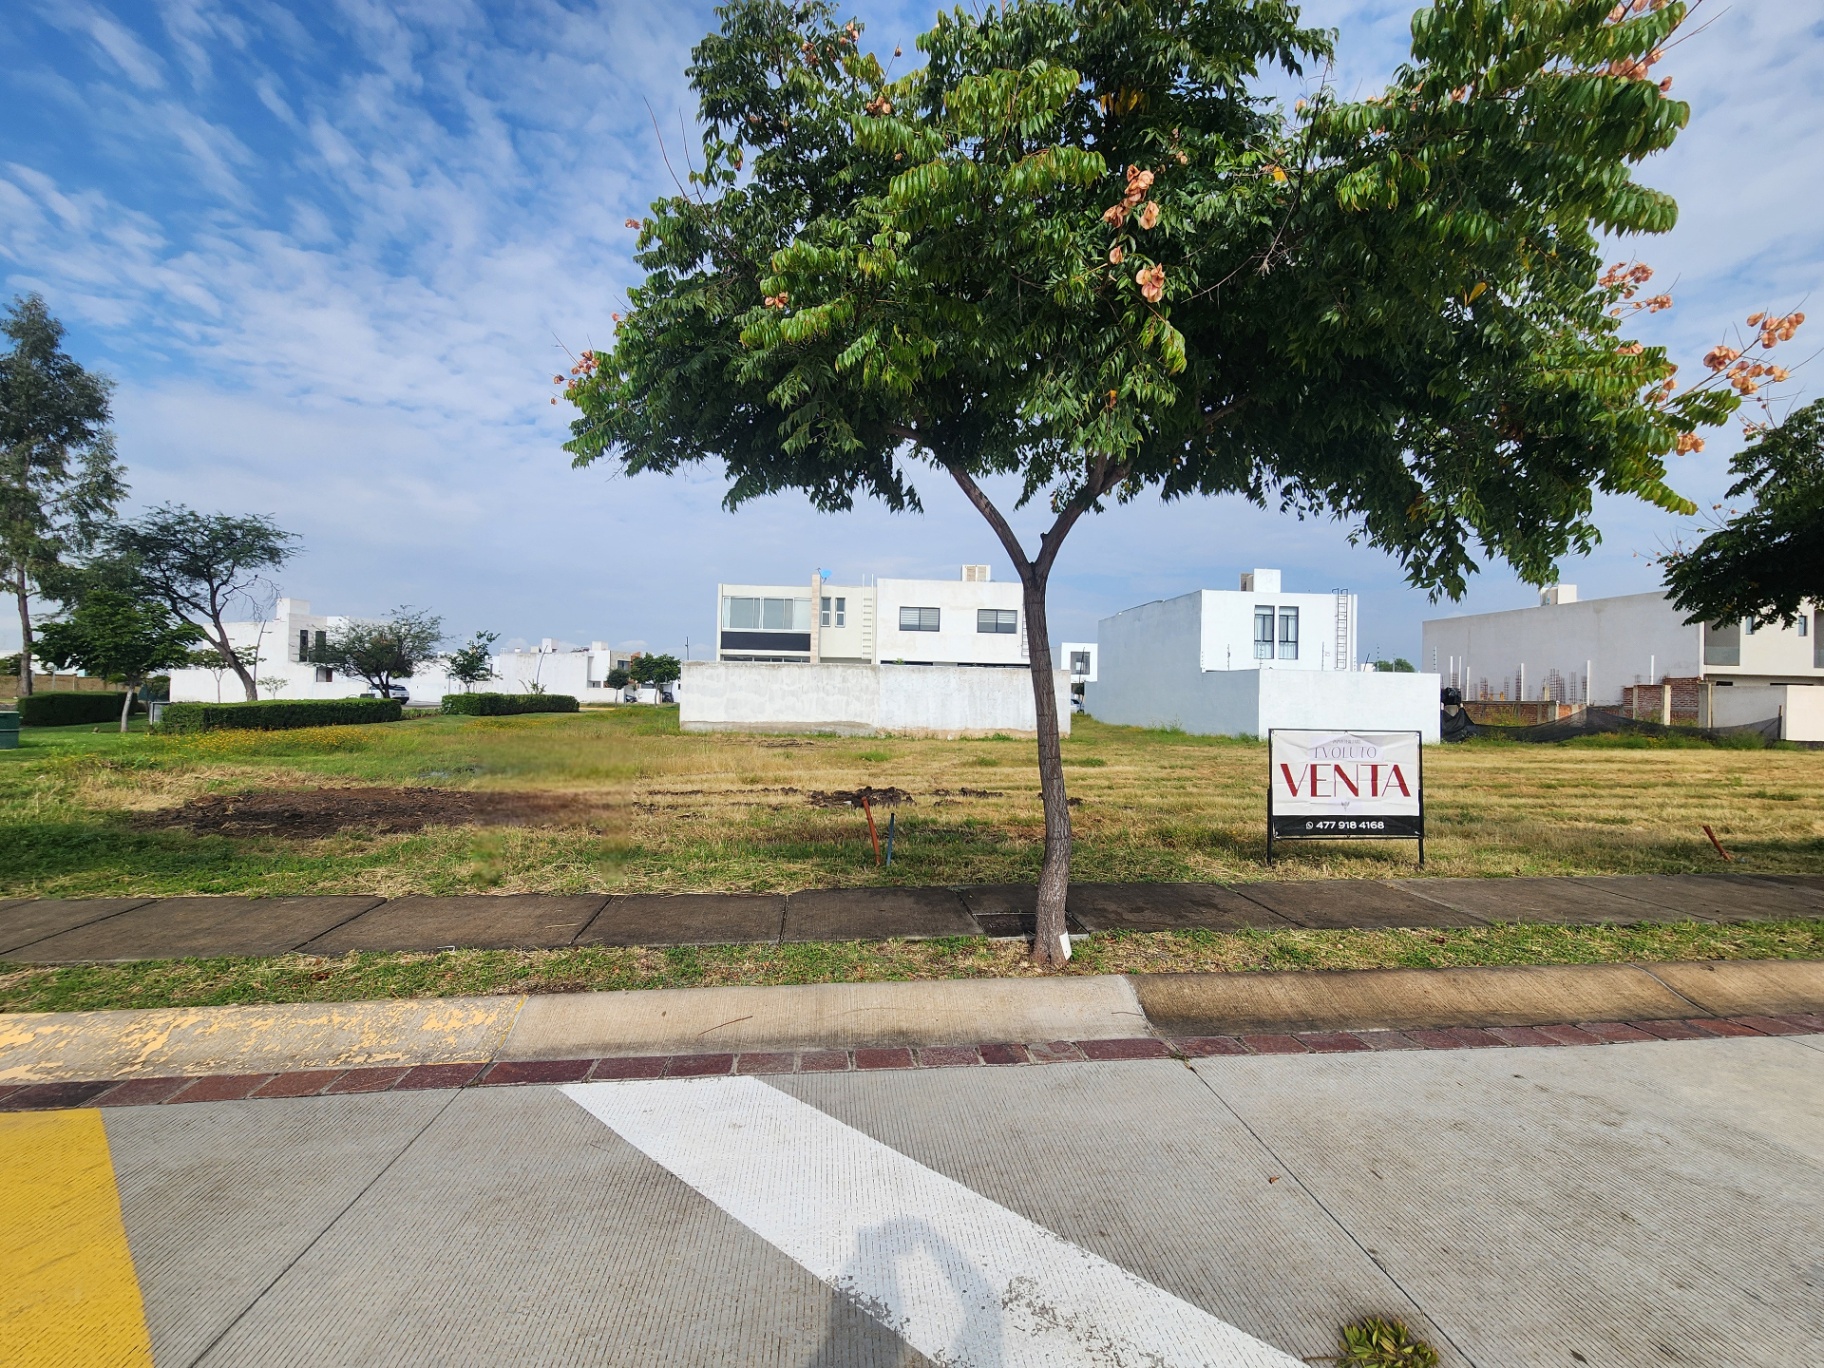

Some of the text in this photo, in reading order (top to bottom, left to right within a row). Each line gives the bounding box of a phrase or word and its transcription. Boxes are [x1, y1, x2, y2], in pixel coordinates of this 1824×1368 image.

[1280, 764, 1411, 797] VENTA
[1316, 821, 1385, 830] 477 918 4168
